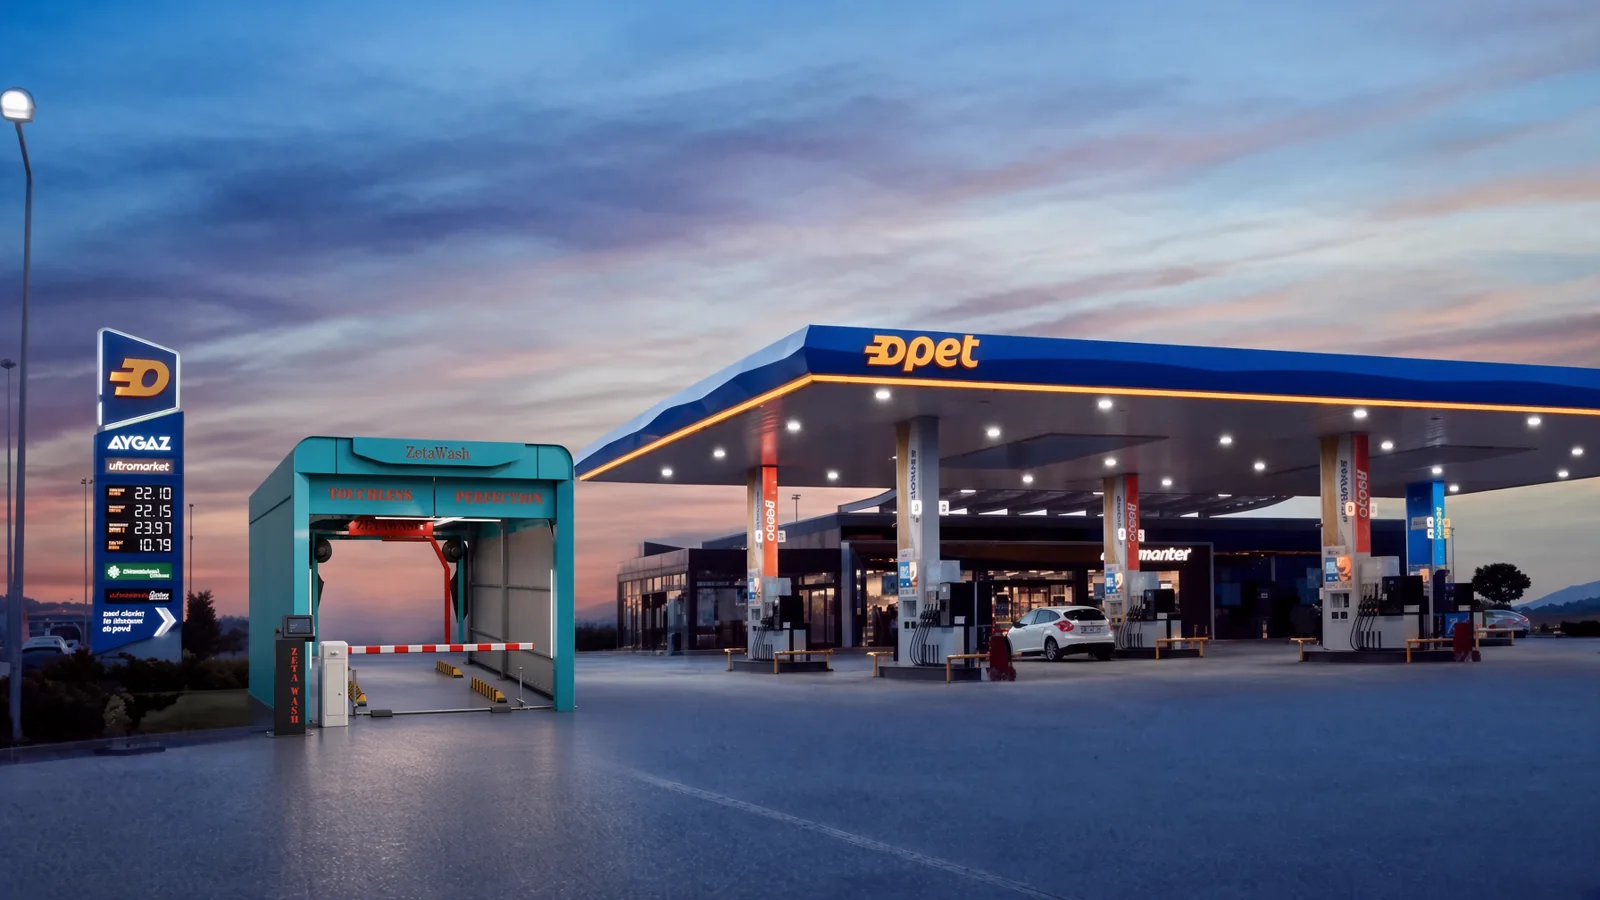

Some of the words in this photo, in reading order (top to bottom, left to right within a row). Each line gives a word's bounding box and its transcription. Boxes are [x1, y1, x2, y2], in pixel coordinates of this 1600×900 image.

[107, 435, 171, 451] AYGAZ
[406, 445, 470, 460] ZetaWash
[134, 487, 172, 500] 22.10
[328, 487, 413, 502] TOUCHLESS
[455, 490, 542, 505] PERFECTION
[134, 504, 172, 518] 22.15
[134, 521, 172, 535] 23.97
[139, 538, 172, 552] 10.79
[290, 647, 298, 682] ZETA
[290, 687, 299, 724] WASH
